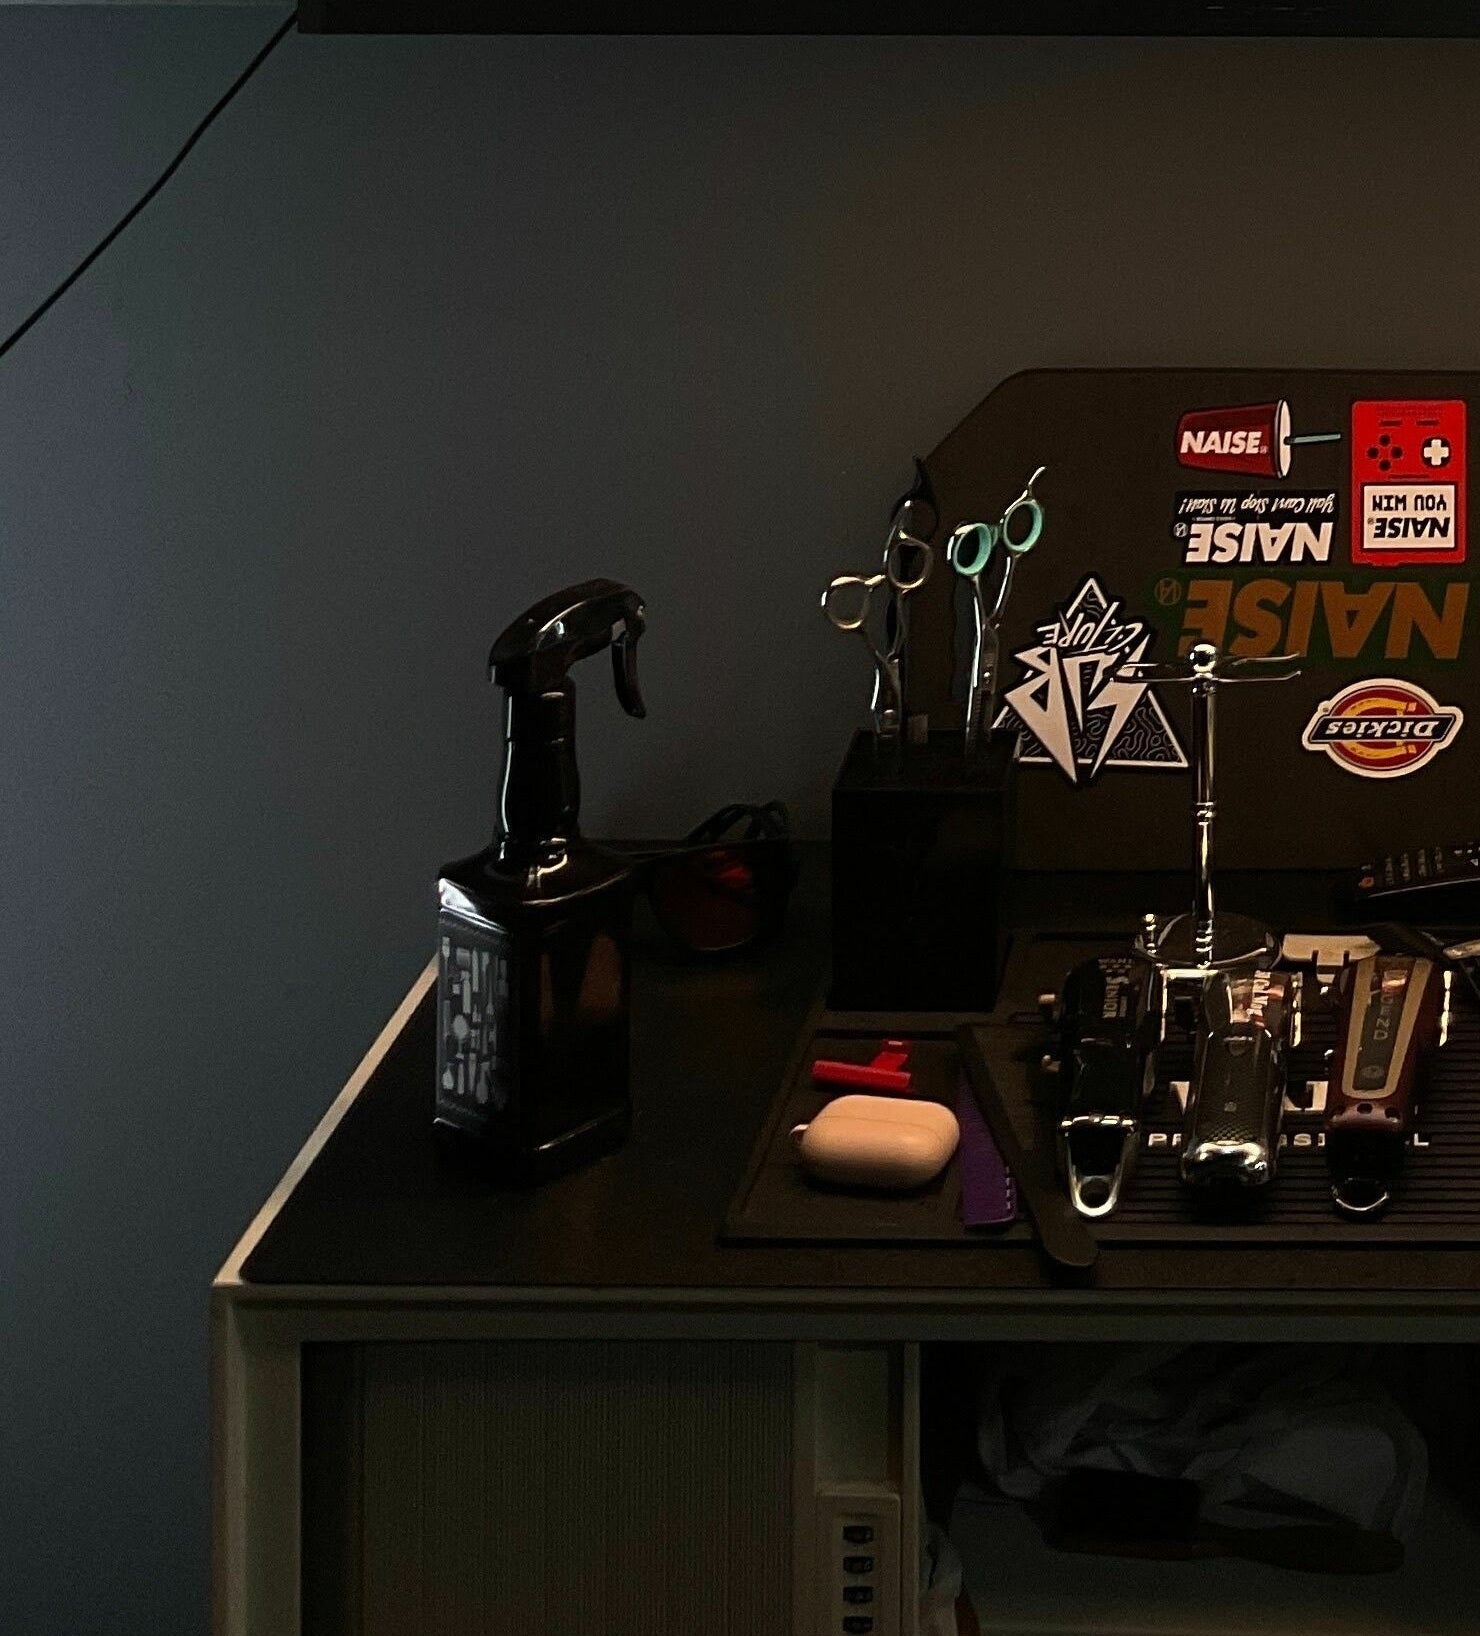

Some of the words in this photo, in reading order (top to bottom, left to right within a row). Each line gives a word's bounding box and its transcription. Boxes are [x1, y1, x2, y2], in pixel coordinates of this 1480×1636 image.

[1372, 494, 1407, 511] WIN
[1414, 494, 1447, 511] YOU
[1373, 517, 1450, 538] NAISE
[1186, 521, 1334, 563] NAISE
[1177, 578, 1469, 660] NAISE
[1325, 720, 1439, 738] Dickies
